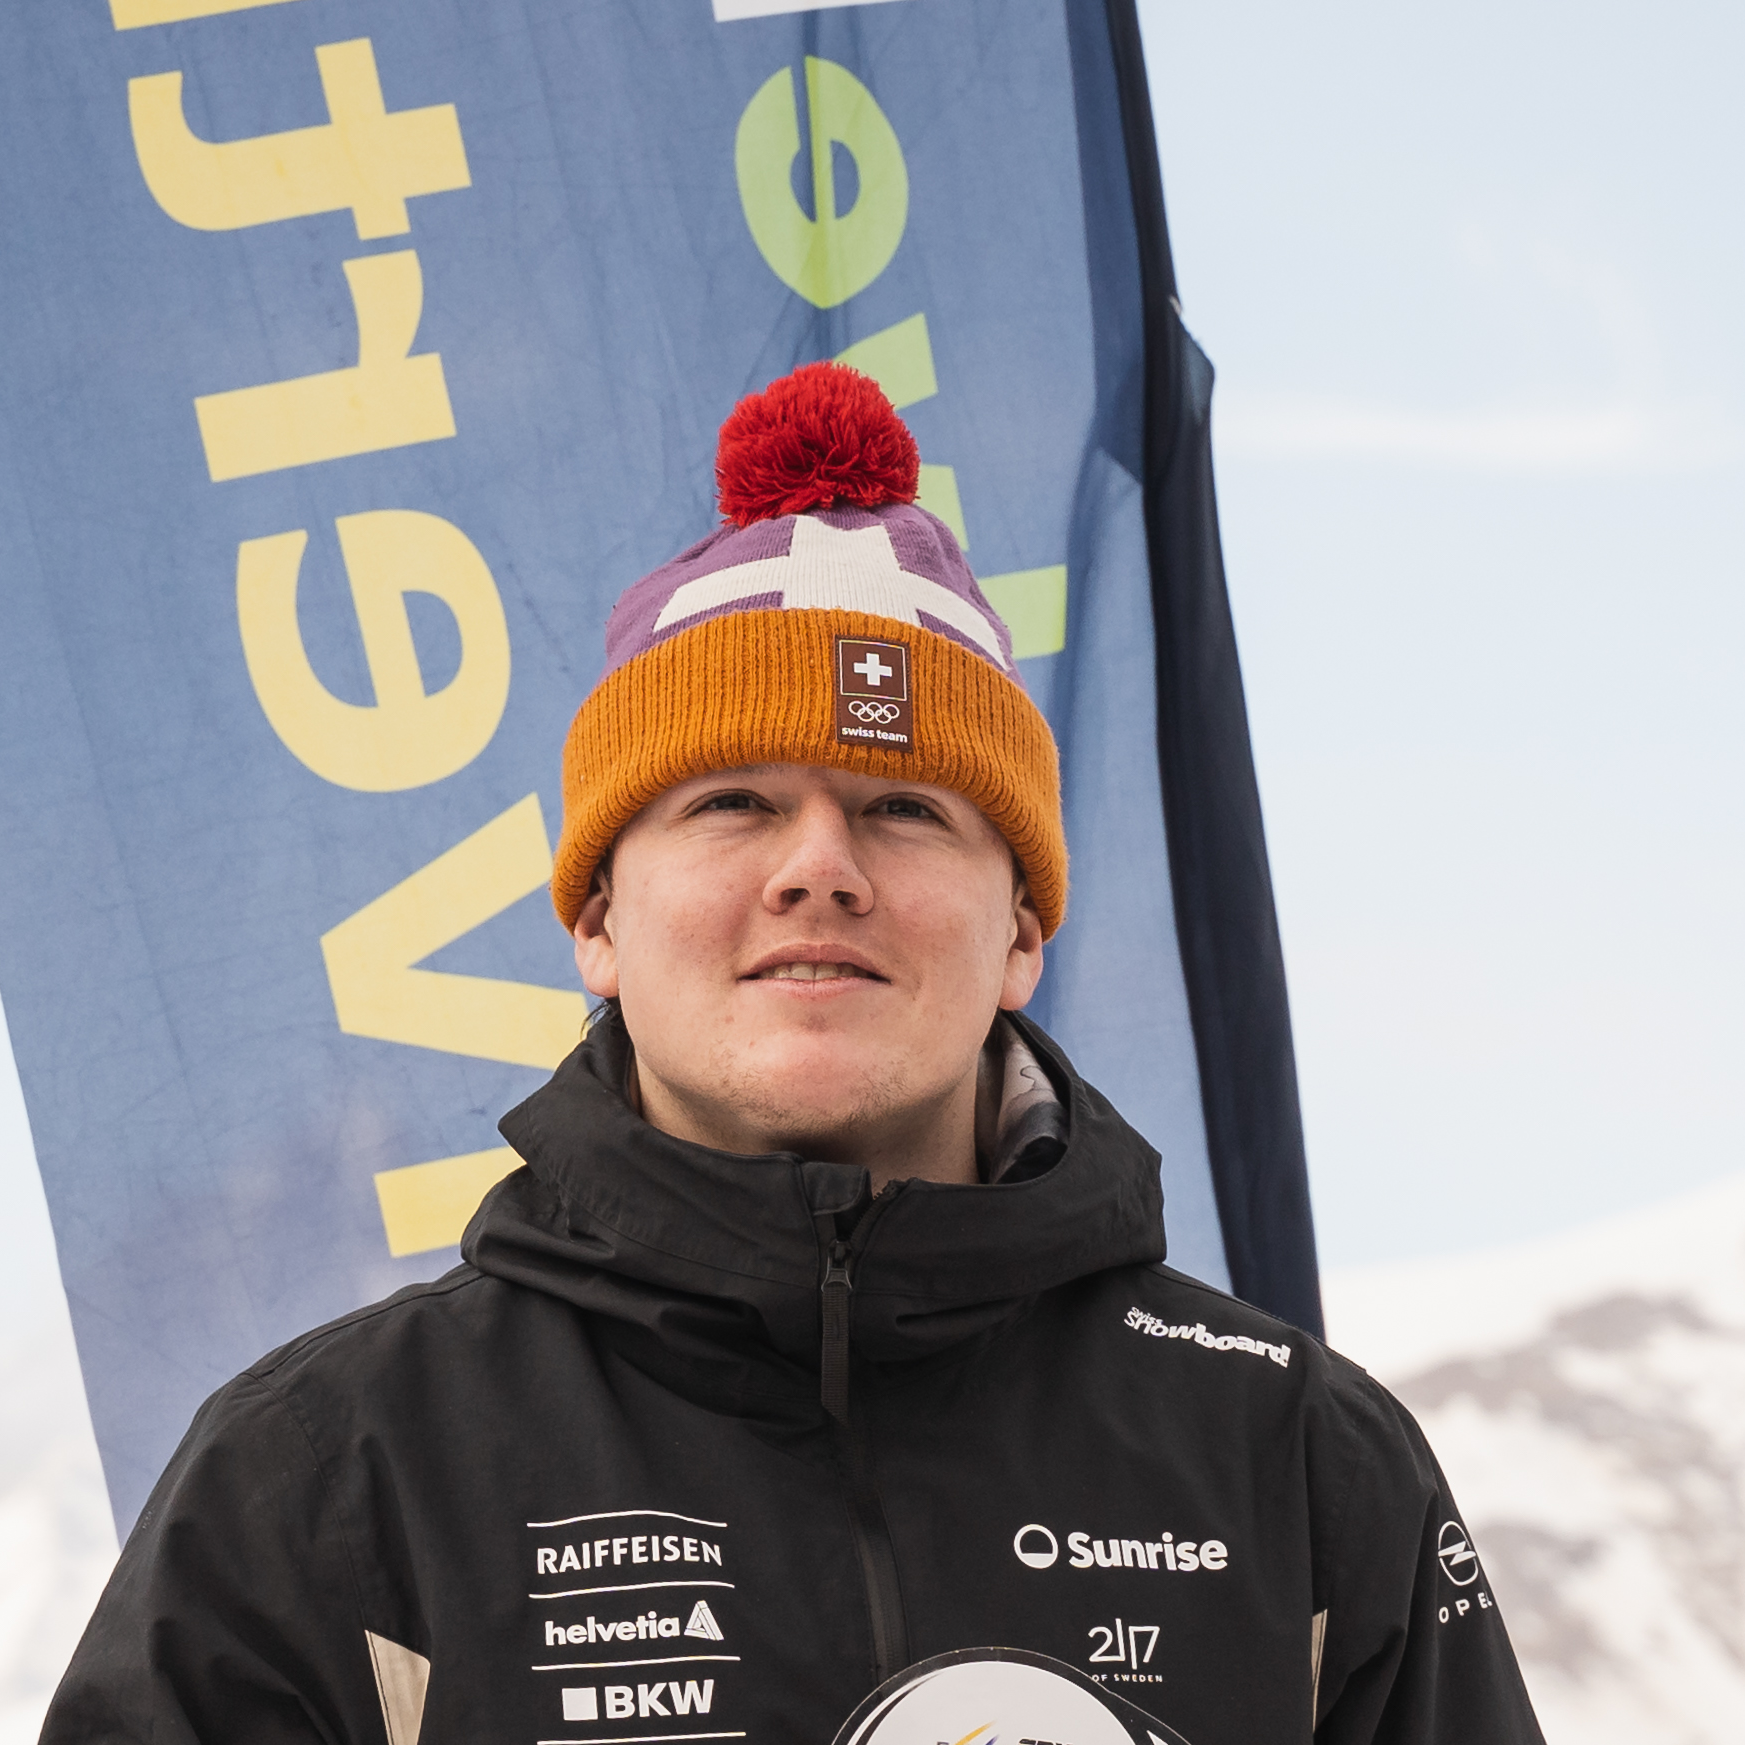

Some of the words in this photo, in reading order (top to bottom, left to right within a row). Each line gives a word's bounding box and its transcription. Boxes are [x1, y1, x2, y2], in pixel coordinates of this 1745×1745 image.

[841, 726, 875, 738] swiss
[876, 729, 908, 743] team
[536, 1535, 723, 1575] RAIFFEISEN
[1067, 1531, 1228, 1572] Sunrise
[544, 1610, 680, 1646] helvetia
[1091, 1674, 1108, 1682] OF
[1113, 1673, 1163, 1683] SWEDEN
[604, 1678, 715, 1719] BKW
